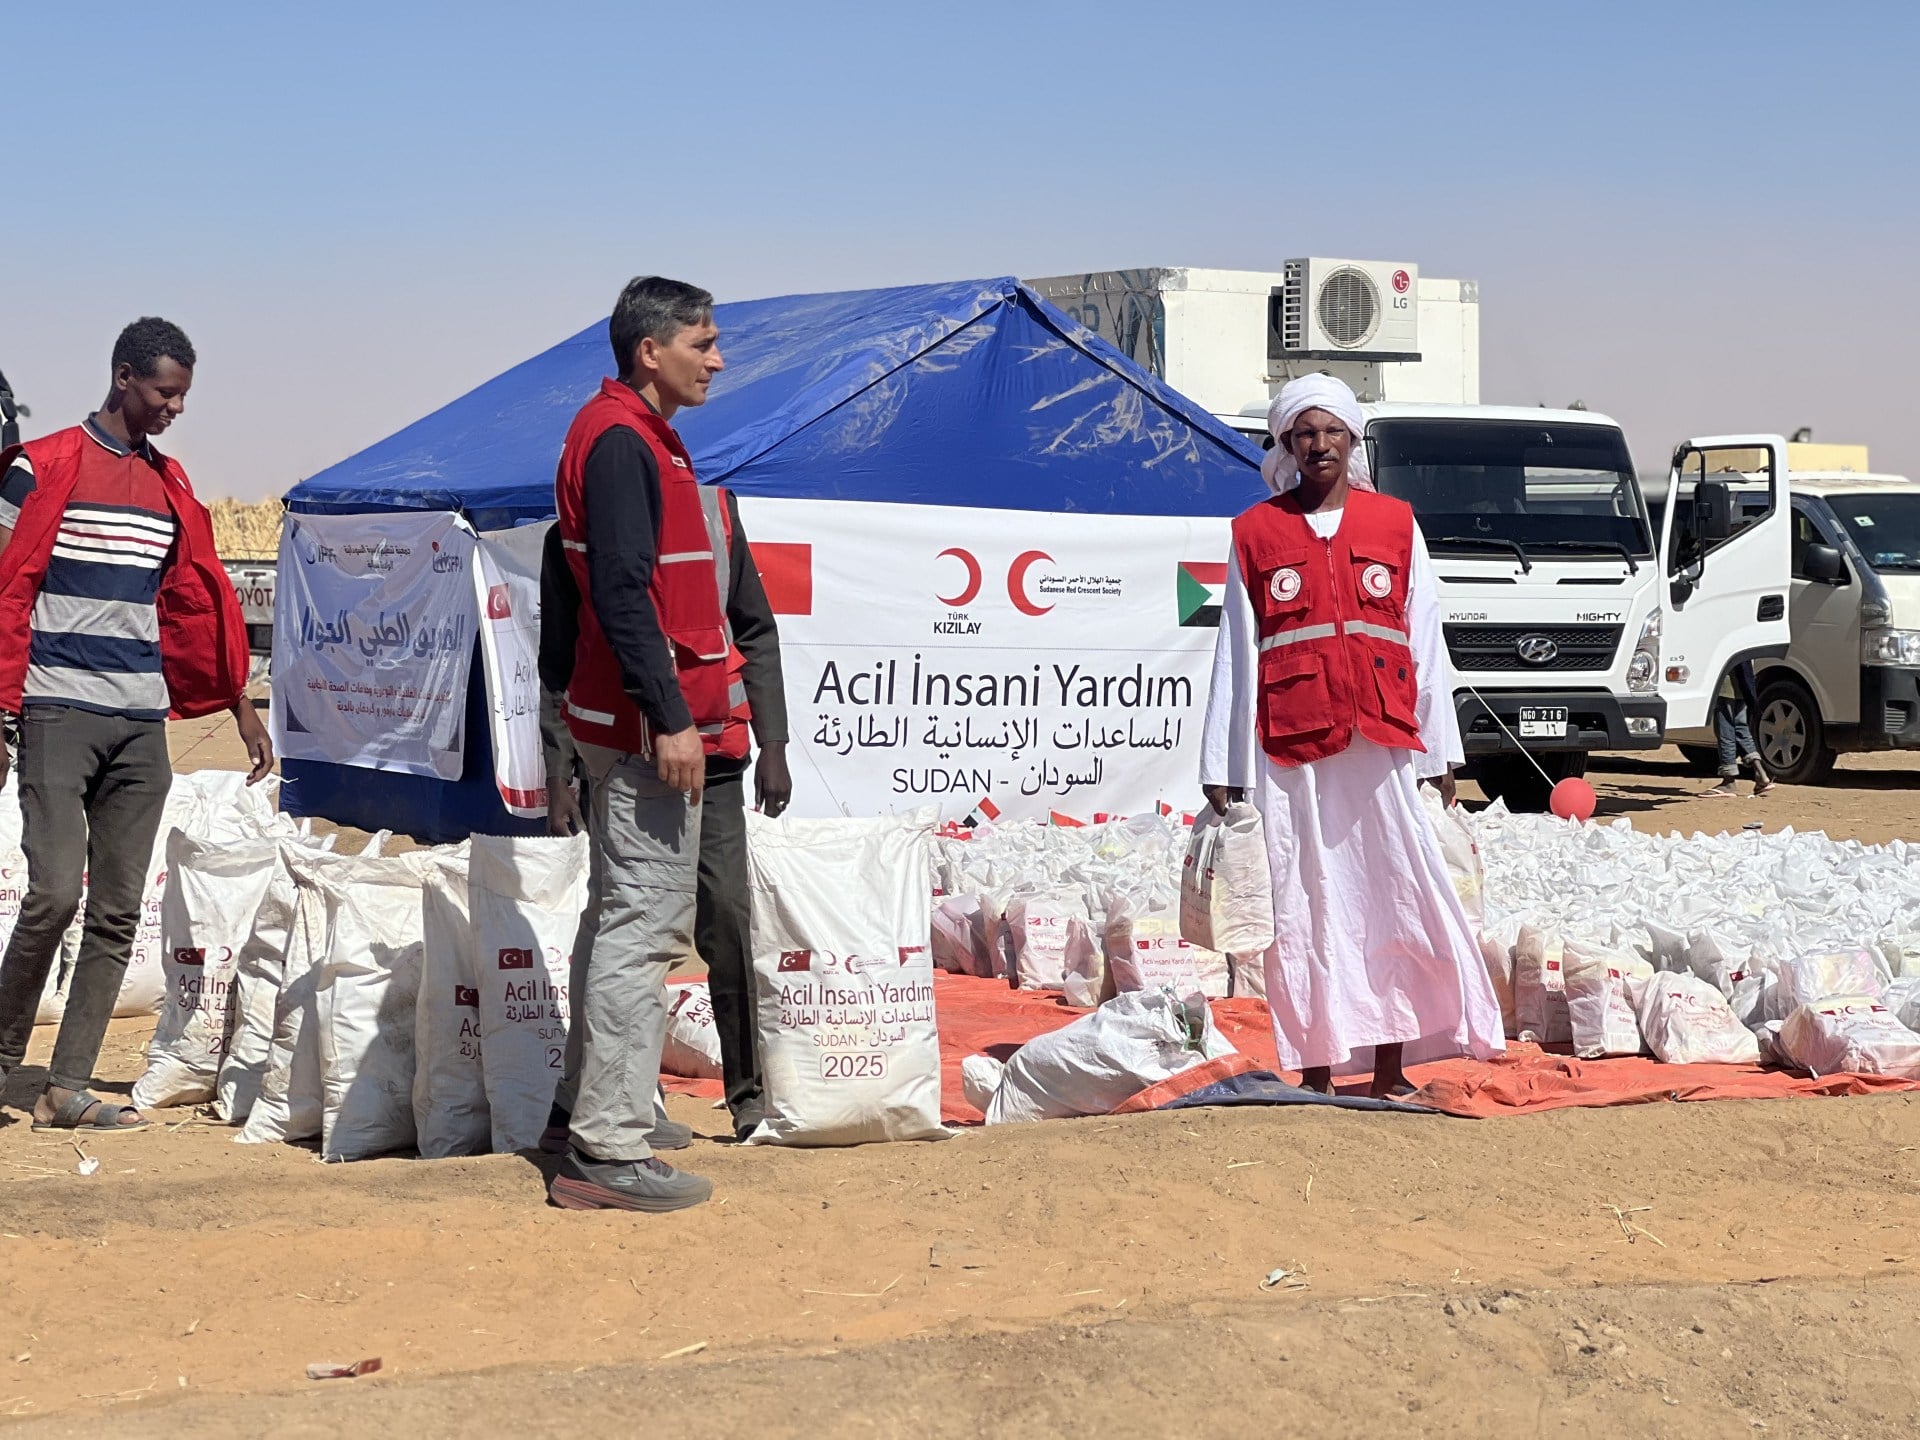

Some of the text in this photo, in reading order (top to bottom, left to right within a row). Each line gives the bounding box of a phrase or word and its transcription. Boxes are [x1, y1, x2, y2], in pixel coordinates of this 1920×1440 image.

[1393, 296, 1408, 309] LG
[235, 586, 275, 607] OYOT
[1039, 585, 1065, 593] Sudanese
[1077, 586, 1101, 594] Crescent
[1102, 587, 1121, 596] Society
[947, 611, 969, 621] TÜRK
[1449, 612, 1488, 621] HYUNDAI
[1576, 612, 1621, 621] MIGHTY
[933, 621, 982, 635] KIZILAY
[359, 611, 410, 667] الطبي
[813, 653, 1192, 707] Acil İnsani Yardım
[1522, 710, 1562, 720] NGO 216
[813, 713, 1182, 761] المساعدات الإنسانية الطارئة
[893, 768, 991, 793] SUDAN
[1020, 756, 1103, 796] السودان
[0, 886, 21, 901] ani
[178, 973, 233, 995] Acil İns
[504, 978, 568, 1002] Acil İns
[780, 980, 934, 1006] Acil İnsani Yardım
[506, 1004, 544, 1023] الطارئة
[780, 1006, 933, 1031] المساعدات الإنسانية الطارئة
[203, 1019, 235, 1029] SUDA
[459, 1018, 482, 1038] Ac
[209, 1036, 230, 1054] 20
[813, 1034, 858, 1047] SUDAN
[869, 1027, 906, 1047] السودان
[824, 1055, 884, 1078] 2025
